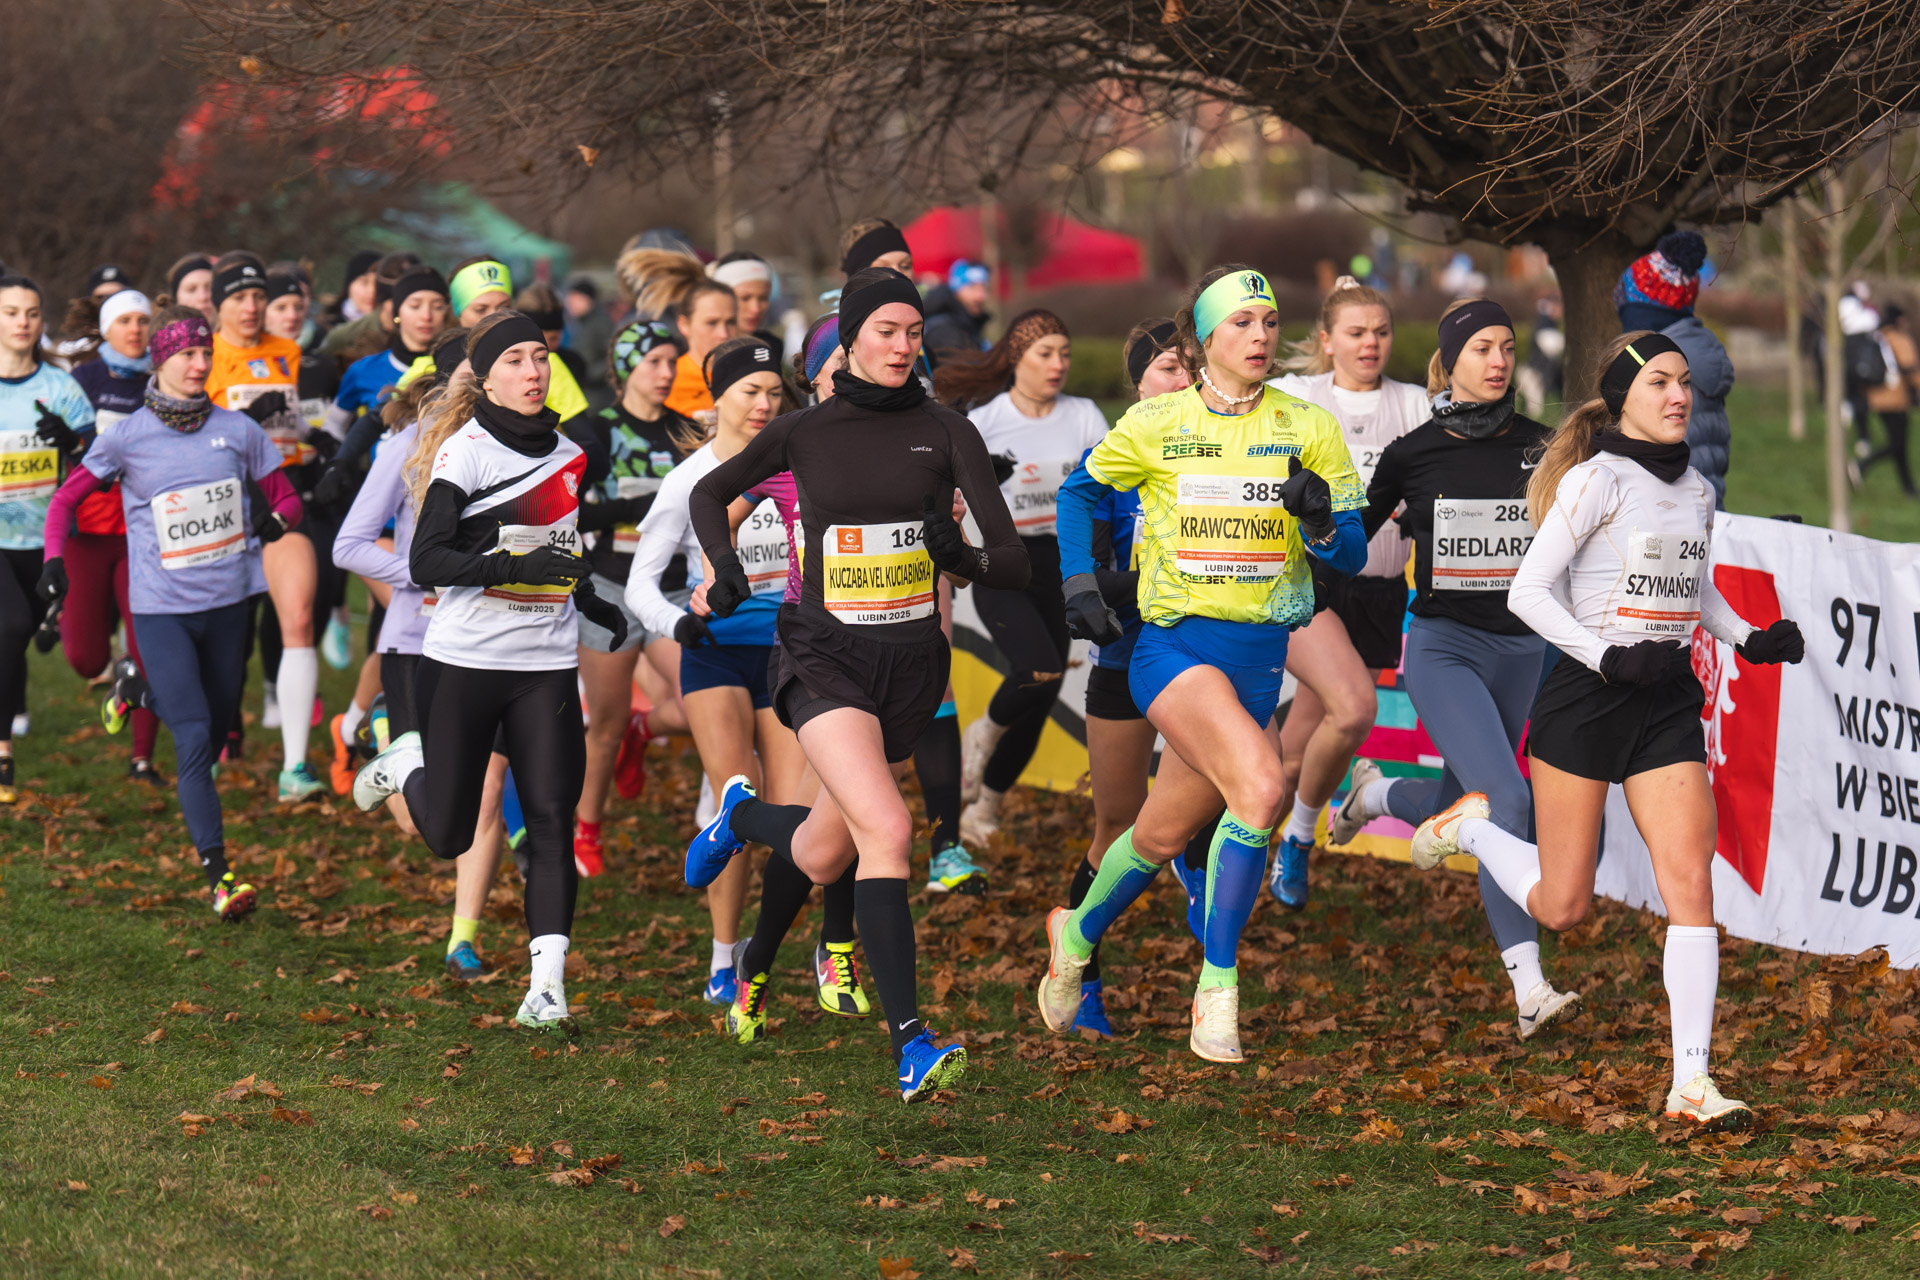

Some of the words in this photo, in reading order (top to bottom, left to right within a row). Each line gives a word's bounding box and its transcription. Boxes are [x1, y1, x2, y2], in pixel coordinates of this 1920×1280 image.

[1441, 400, 1464, 415] GL
[1162, 434, 1207, 443] GRUSZFELD
[204, 483, 234, 504] 155
[1242, 482, 1282, 502] 385
[752, 513, 785, 530] 594
[1494, 504, 1529, 522] 286
[168, 510, 234, 540] CIOŁAK
[1180, 514, 1285, 540] KRAWCZYŃSKA
[547, 529, 576, 547] 344
[1437, 537, 1535, 557] SIEDLARZ
[1679, 540, 1706, 560] 246
[829, 567, 868, 589] KUCZABA
[869, 566, 884, 588] VEL
[885, 557, 931, 588] KUCIABIŃSKA
[1205, 564, 1233, 572] LUBIN
[1235, 565, 1258, 573] 2025
[1625, 572, 1700, 598] SZYMAŃSKA
[508, 603, 532, 613] LUBIN
[534, 605, 554, 613] 2025
[857, 613, 887, 622] LUBIN
[889, 609, 911, 620] 2025
[1645, 622, 1670, 632] LUBIN
[1671, 624, 1685, 632] 2025
[1830, 597, 1896, 678] 97.
[1834, 693, 1920, 752] MISTR
[1836, 762, 1867, 812] W
[1877, 771, 1920, 824] BIE
[1820, 832, 1920, 919] LUB
